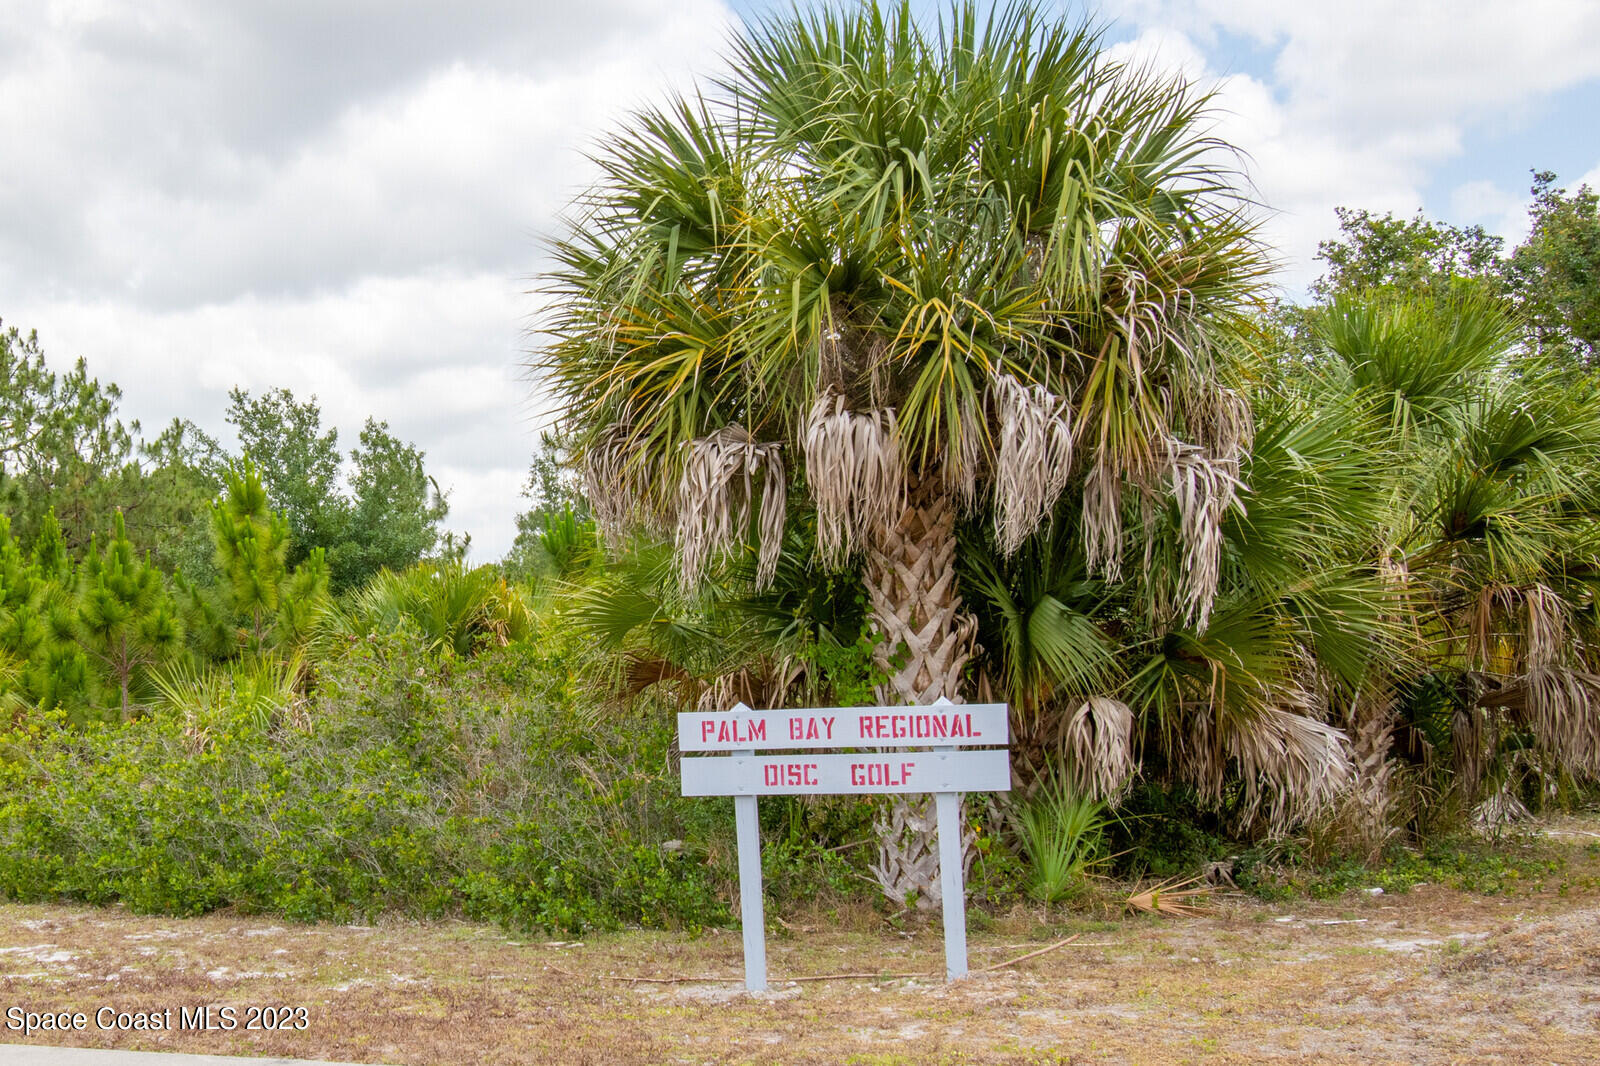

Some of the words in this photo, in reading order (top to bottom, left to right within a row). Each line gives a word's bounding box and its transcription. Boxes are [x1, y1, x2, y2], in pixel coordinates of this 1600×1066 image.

[702, 719, 767, 743] PALM
[789, 717, 835, 741] BAY
[859, 714, 982, 739] REGIONAL
[764, 764, 818, 787] DISC
[851, 763, 915, 787] GOLF
